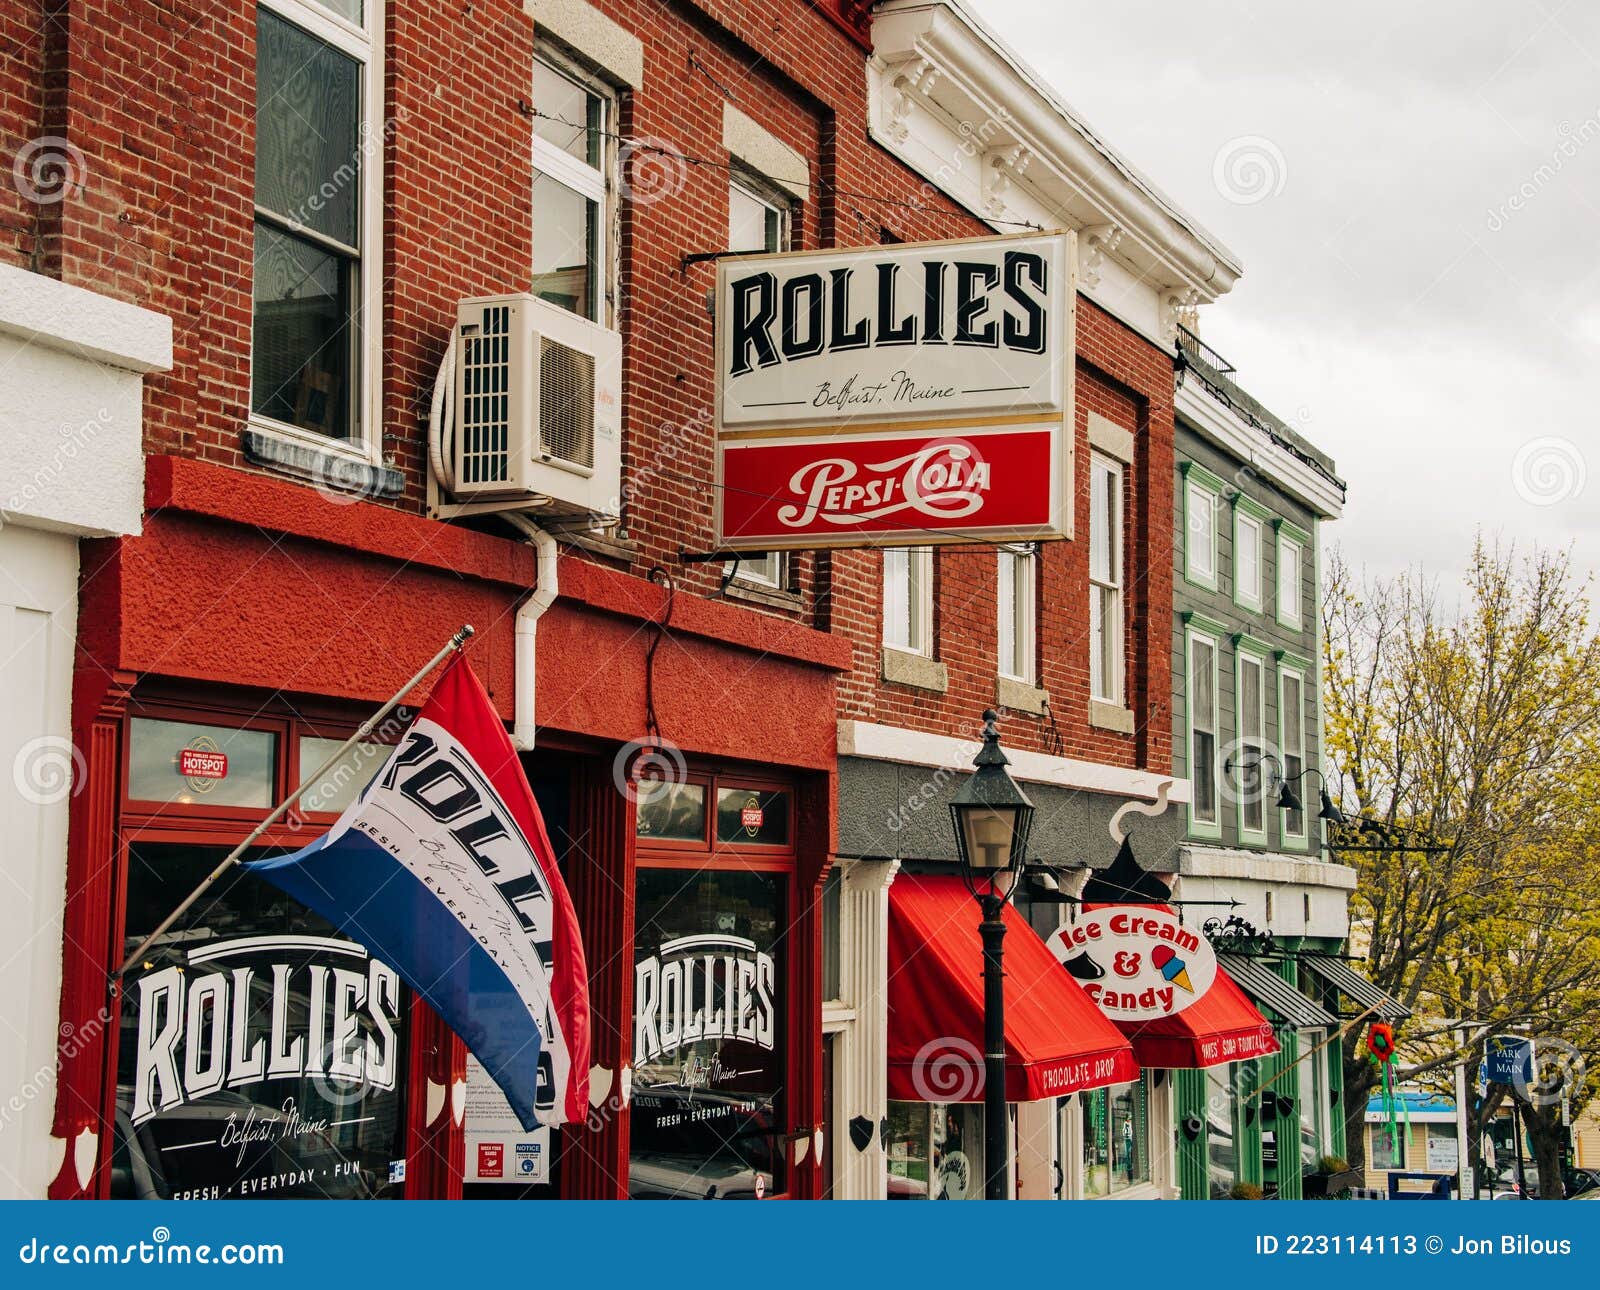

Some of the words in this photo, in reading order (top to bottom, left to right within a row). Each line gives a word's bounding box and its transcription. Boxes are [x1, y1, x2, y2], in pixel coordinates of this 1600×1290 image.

[729, 250, 1047, 379] ROLLIES
[891, 370, 955, 403] Maine
[183, 757, 224, 771] HOTSPOT
[424, 876, 510, 968] EVERYDAY
[1058, 921, 1102, 951] Ice
[1109, 913, 1200, 953] Cream
[1113, 951, 1142, 978] &
[635, 951, 775, 1070] ROLLIES
[1083, 983, 1174, 1014] Candy
[131, 958, 399, 1127] ROLLIES
[1496, 1049, 1520, 1059] PARK
[712, 1052, 737, 1083] Maine
[1043, 1062, 1089, 1089] CHOCOLATE
[1095, 1057, 1114, 1079] DROP
[1496, 1063, 1522, 1074] MAIN
[282, 1096, 328, 1139] Maine
[656, 1113, 681, 1128] FRESH
[691, 1105, 731, 1121] EVERYDAY
[741, 1101, 756, 1113] FUN
[241, 1168, 314, 1194] EVERYDAY
[335, 1160, 360, 1177] FUN
